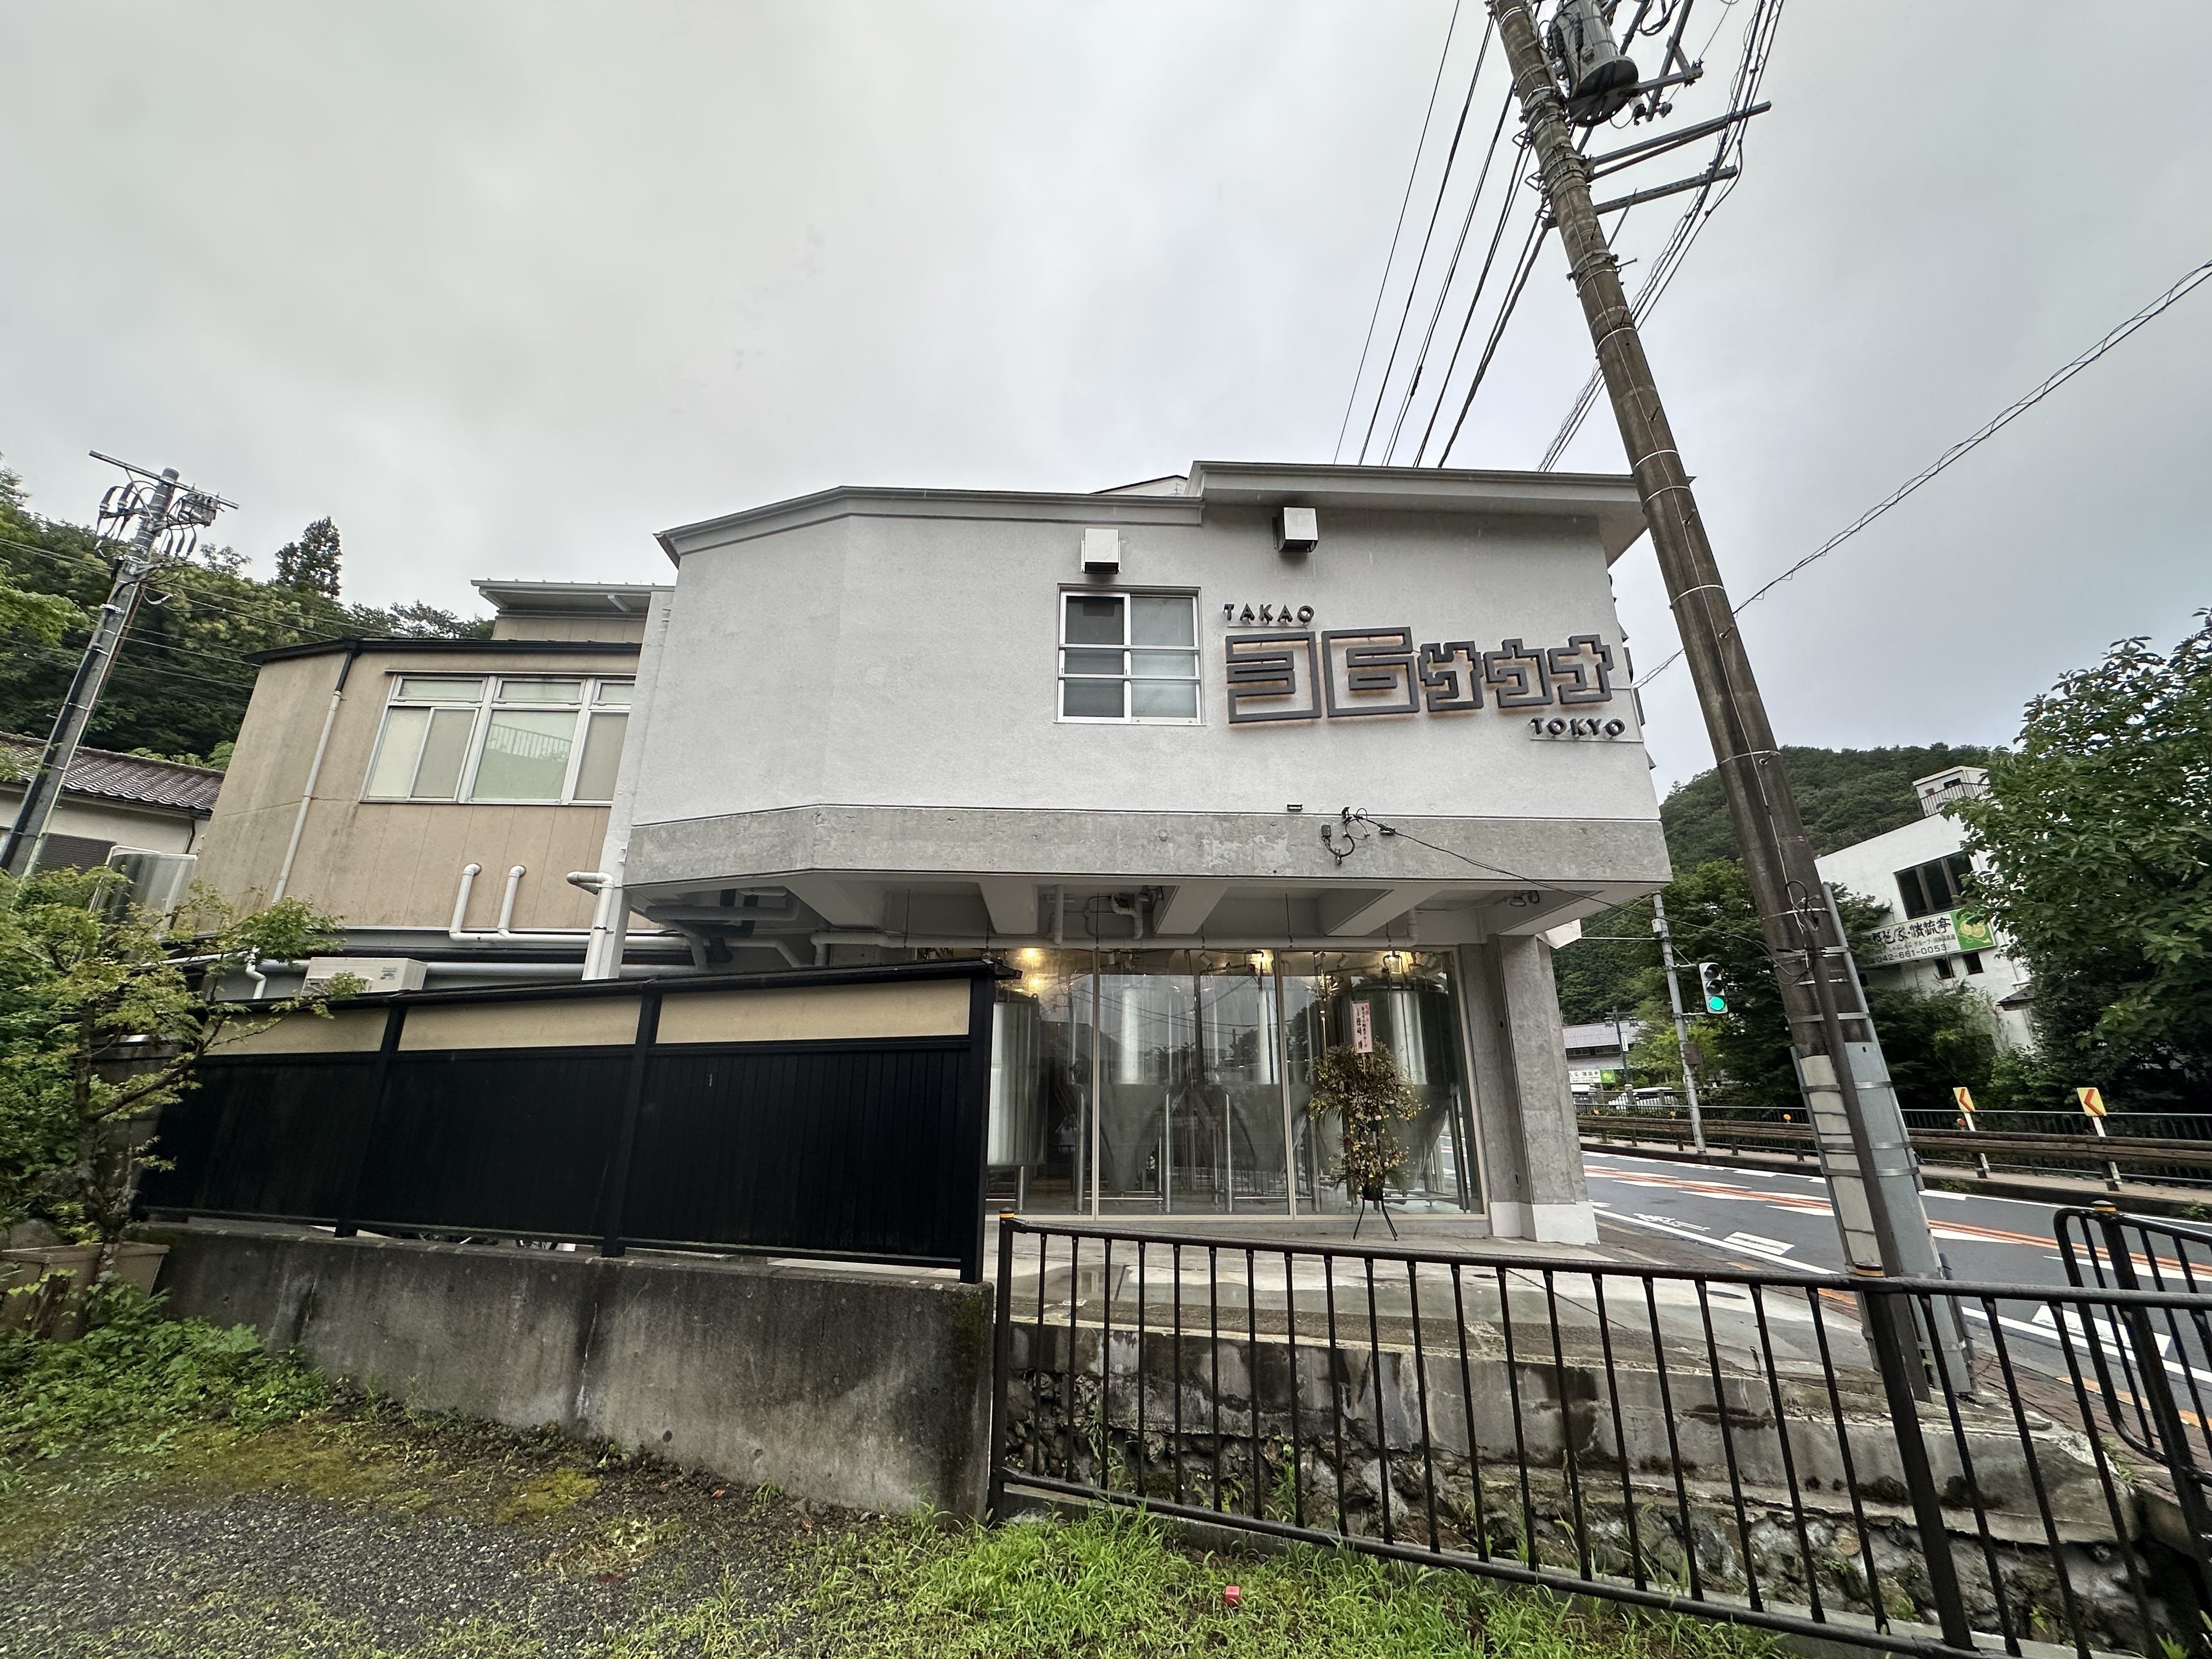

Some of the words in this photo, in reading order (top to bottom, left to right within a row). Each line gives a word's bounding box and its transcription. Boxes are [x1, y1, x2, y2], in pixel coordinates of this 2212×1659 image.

[1223, 603, 1314, 625] TAKAO
[1529, 717, 1626, 737] TOKYO
[1876, 944, 1947, 963] 042-661-0053
